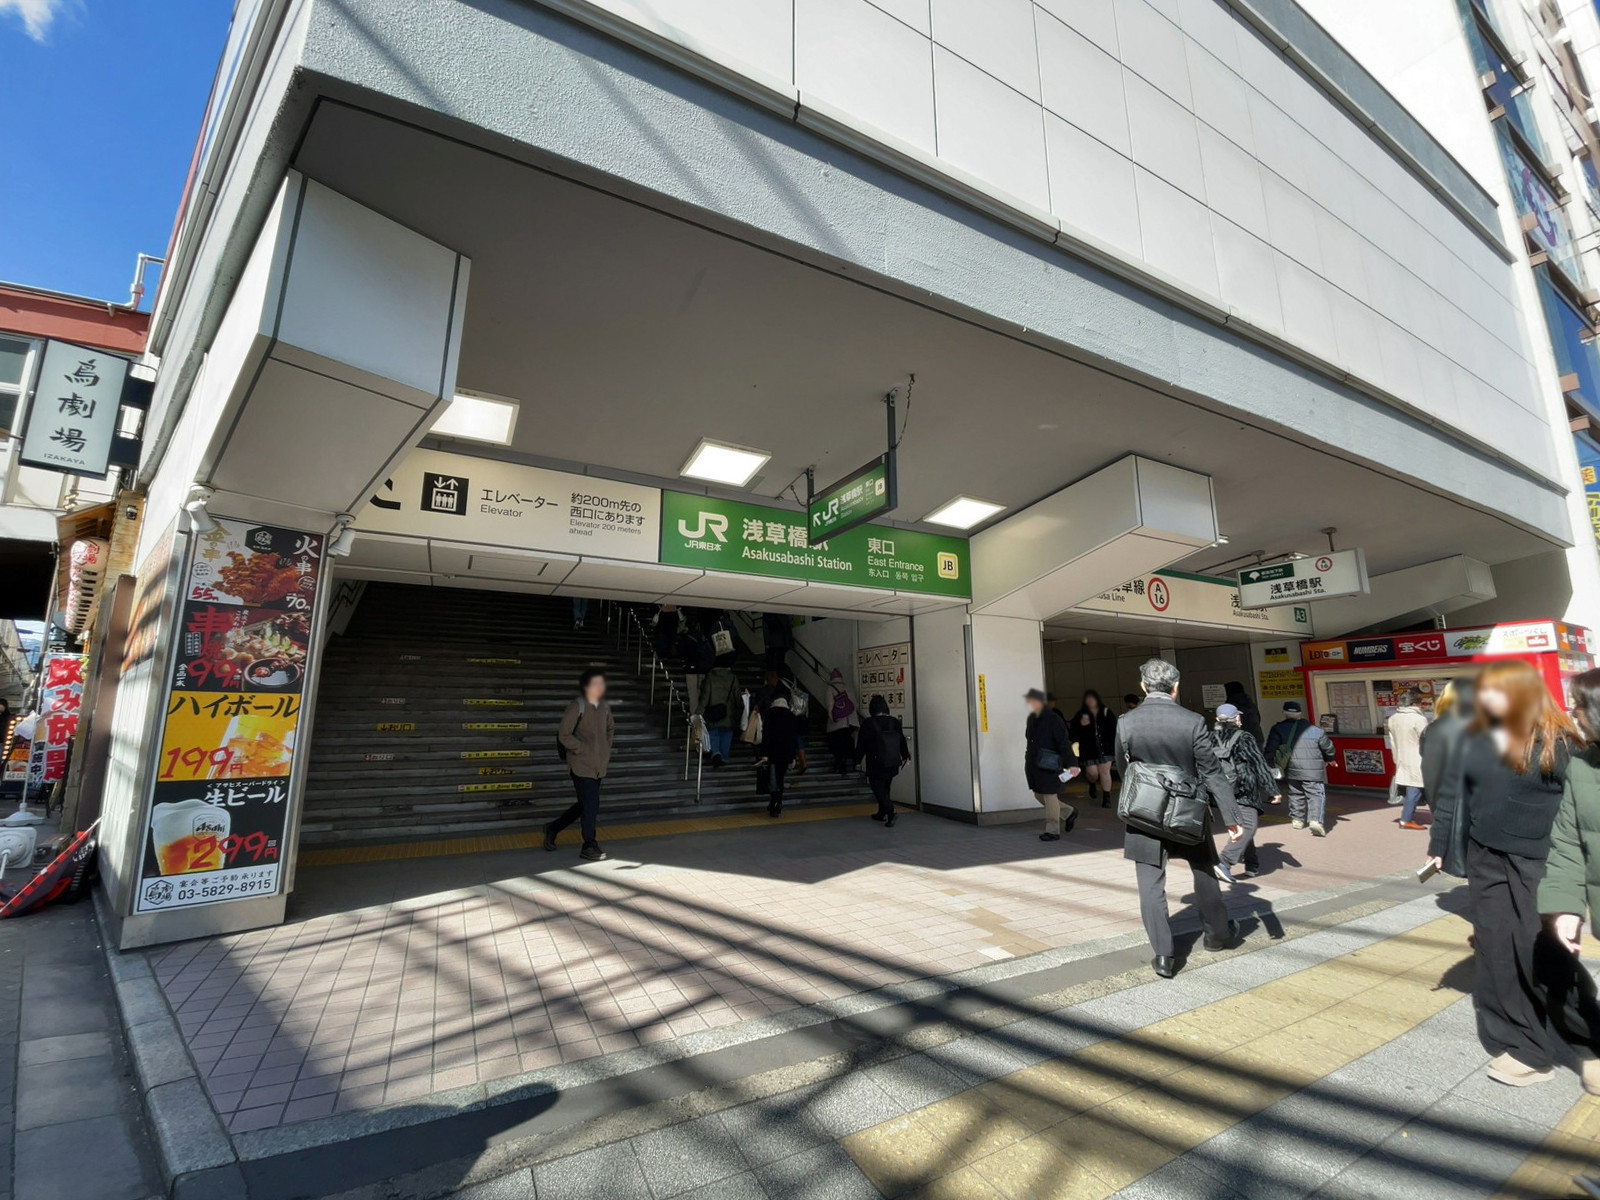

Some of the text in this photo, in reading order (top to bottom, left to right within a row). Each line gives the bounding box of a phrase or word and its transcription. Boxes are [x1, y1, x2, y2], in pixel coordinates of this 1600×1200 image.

[43, 453, 86, 465] IZAKAYA
[481, 489, 559, 510] エレベーター
[571, 492, 642, 513] 約200m先の
[480, 504, 523, 519] Elevator
[570, 506, 646, 527] 西口にあります
[822, 497, 840, 521] JR
[569, 518, 642, 535] Elevator 200 meters
[569, 526, 593, 537] ahead
[678, 511, 729, 543] JR
[684, 540, 722, 552] JR東日本
[867, 537, 895, 556] 東口
[742, 546, 853, 571] Asakusabashi Station
[867, 556, 924, 572] East Entrance
[942, 560, 954, 571] JB
[868, 568, 889, 579] 东入口
[1155, 583, 1162, 593] A
[1270, 576, 1322, 595] 浅草橋駅
[1112, 593, 1126, 602] Line
[1154, 593, 1165, 604] 16
[1270, 587, 1327, 601] Asakusabashi Sta.
[1296, 609, 1306, 622] A3
[1353, 644, 1388, 656] NUMBERS
[1398, 639, 1441, 654] 宝くじ
[858, 649, 907, 665] エレベーター
[862, 672, 894, 684] は西口に
[168, 694, 300, 718] ハイボール
[205, 786, 286, 807] 生ビール
[196, 821, 226, 833] Asahi
[189, 831, 278, 869] 299円
[179, 870, 274, 888] 宴会等ご予約承ります
[178, 878, 272, 901] 03-5829-8915
